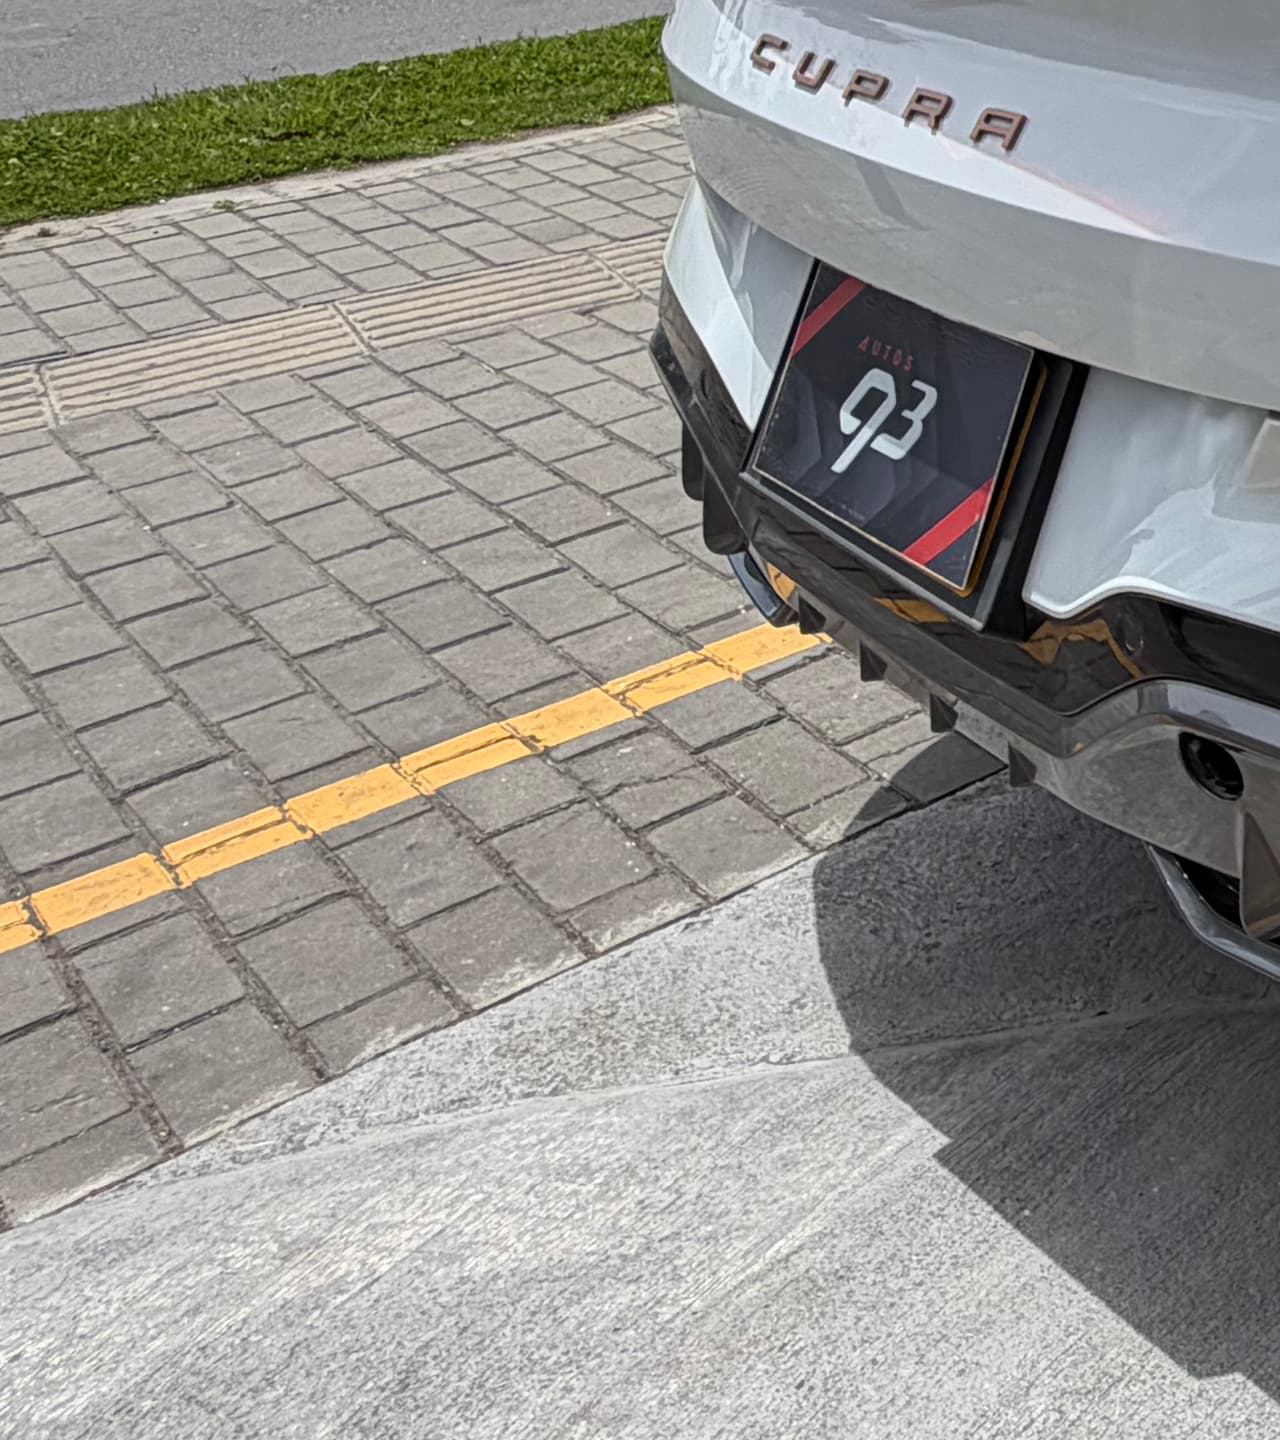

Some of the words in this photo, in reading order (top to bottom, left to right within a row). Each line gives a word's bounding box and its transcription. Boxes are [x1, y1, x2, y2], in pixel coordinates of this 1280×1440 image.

[751, 33, 1029, 152] CUPRA
[858, 335, 914, 372] AUTOS
[830, 368, 938, 474] 93
